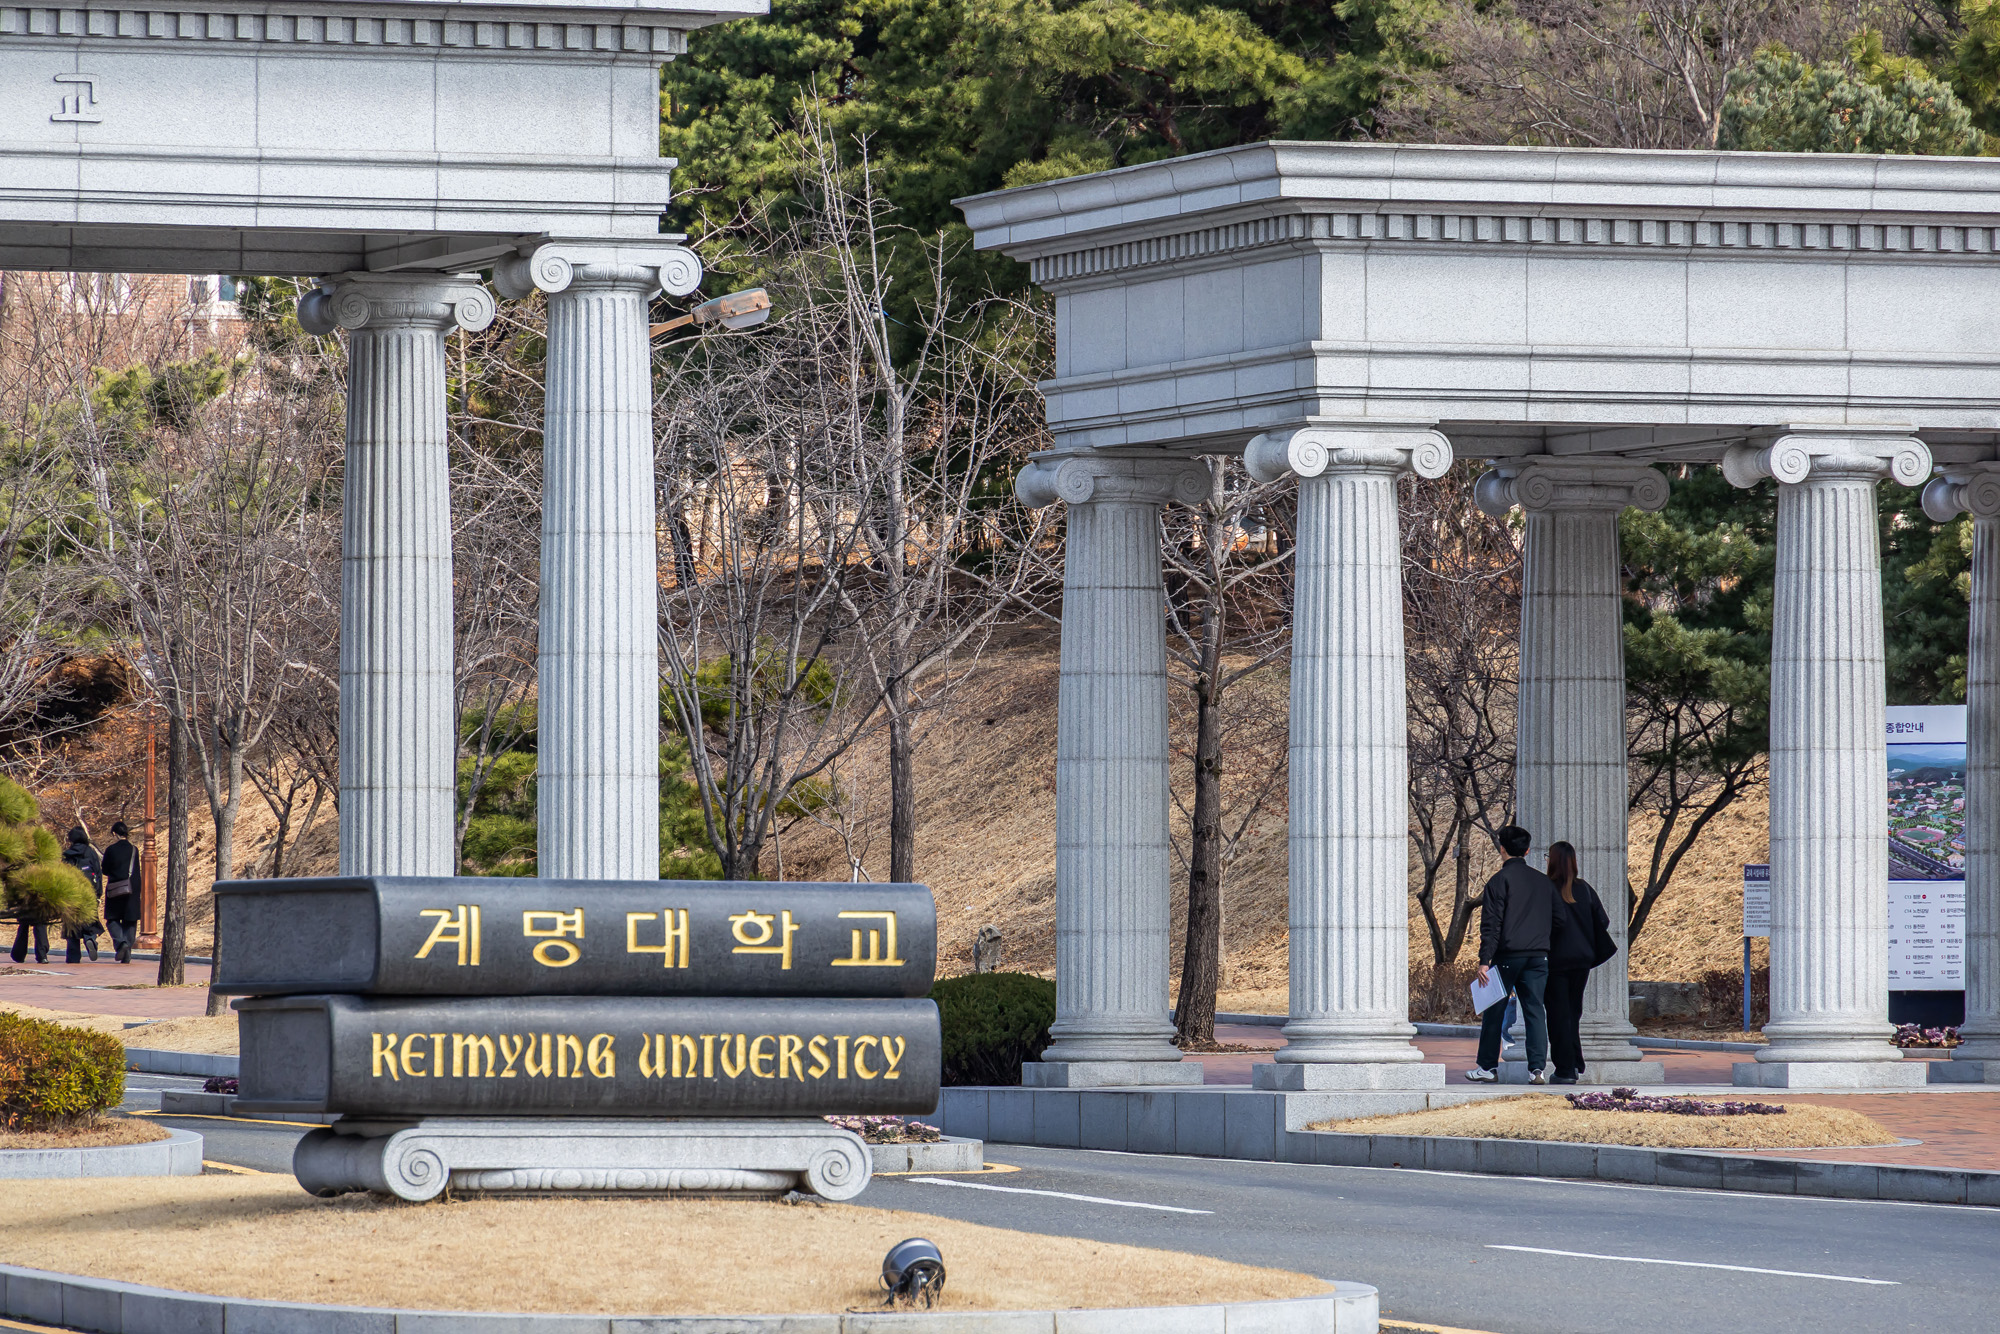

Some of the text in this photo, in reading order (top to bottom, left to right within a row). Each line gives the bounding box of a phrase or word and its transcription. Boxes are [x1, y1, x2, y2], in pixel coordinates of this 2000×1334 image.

[50, 73, 103, 124] 교
[1886, 722, 1924, 733] 종합안내
[415, 904, 906, 970] 계명대학교
[372, 1032, 906, 1082] KEIMYUNG UNIVERSITY
